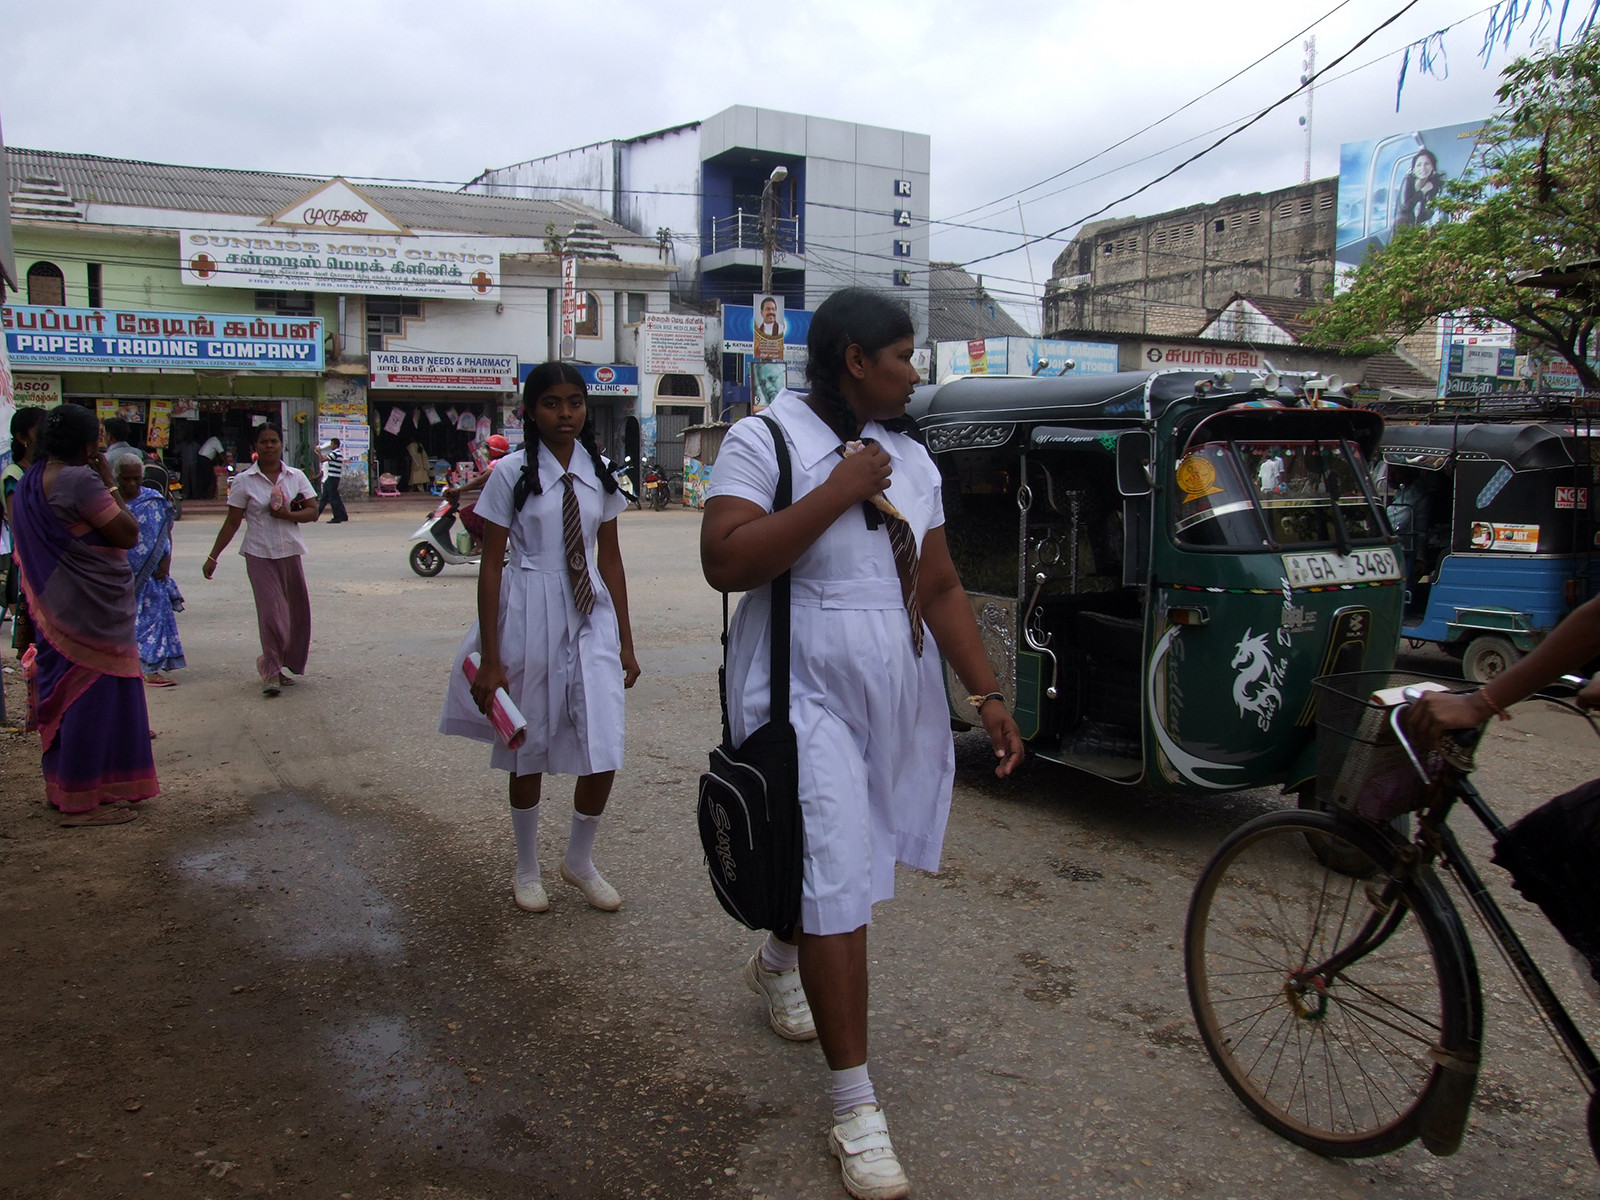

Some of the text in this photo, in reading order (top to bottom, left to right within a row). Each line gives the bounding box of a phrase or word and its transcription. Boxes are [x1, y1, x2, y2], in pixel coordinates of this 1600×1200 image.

[189, 234, 494, 265] SUNRISE MEDI CLINIC
[16, 334, 310, 360] PAPER TRADING COMPANY
[376, 355, 511, 368] YARL BABY NEEDS & PHARMACY
[1225, 351, 1258, 367] கபே
[1081, 361, 1114, 373] STORES
[12, 382, 50, 391] ASCO
[595, 384, 621, 392] CLINIC
[1557, 488, 1585, 502] NGK
[1306, 556, 1337, 580] GA
[1350, 552, 1397, 576] 3489
